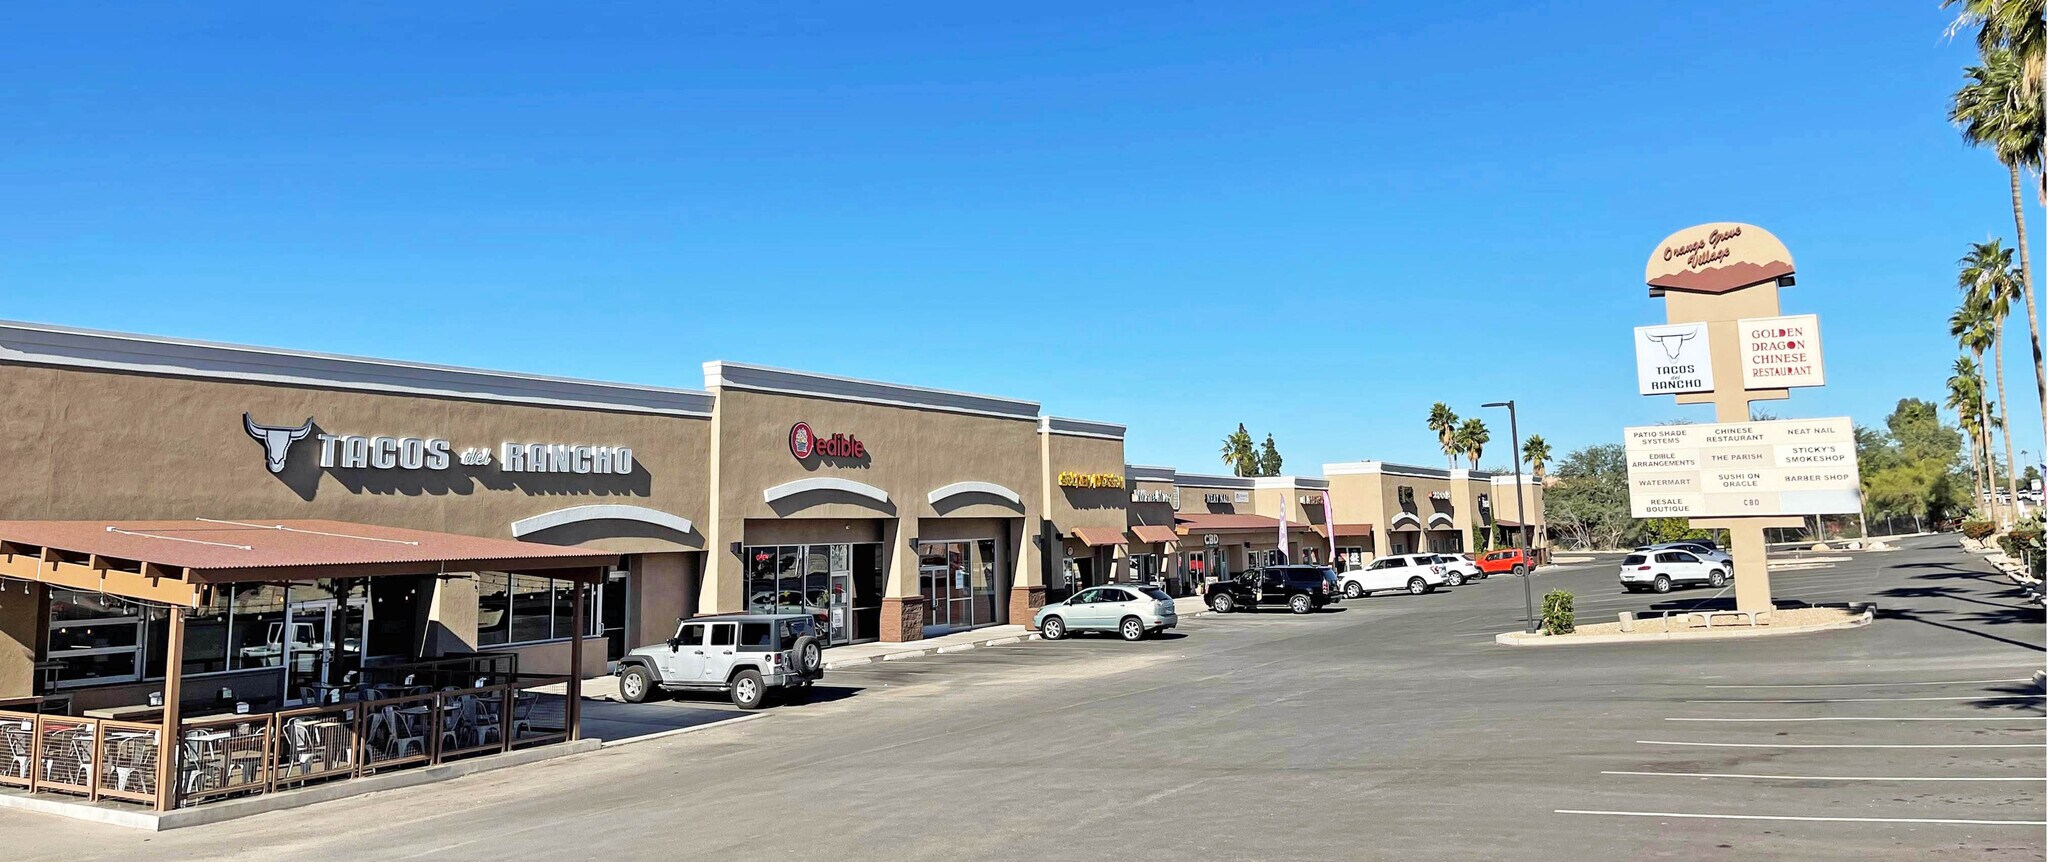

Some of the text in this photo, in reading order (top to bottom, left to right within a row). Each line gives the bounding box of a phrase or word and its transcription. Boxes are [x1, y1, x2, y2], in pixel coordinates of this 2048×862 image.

[1664, 226, 1742, 261] Orange Grove
[1687, 247, 1730, 269] Village
[1751, 327, 1803, 339] GOLDEN
[1752, 340, 1805, 352] DRAGON
[1752, 353, 1807, 364] CHINESE
[1656, 364, 1695, 375] TACOS
[1752, 365, 1812, 378] RESTAURANT
[1651, 379, 1702, 390] RANCHO
[1715, 427, 1753, 435] CHINESE
[1642, 437, 1680, 445] SYSTEMS
[1706, 434, 1764, 442] RESTAURANT
[816, 433, 864, 458] edible
[1792, 446, 1836, 454] STICKY'S
[318, 433, 633, 475] TACOS del RANCHO
[1731, 453, 1763, 461] PARISH
[1785, 455, 1845, 463] SMOKESHOP
[1632, 460, 1695, 468] ARRANGEMENTS
[1204, 534, 1219, 545] CBD
